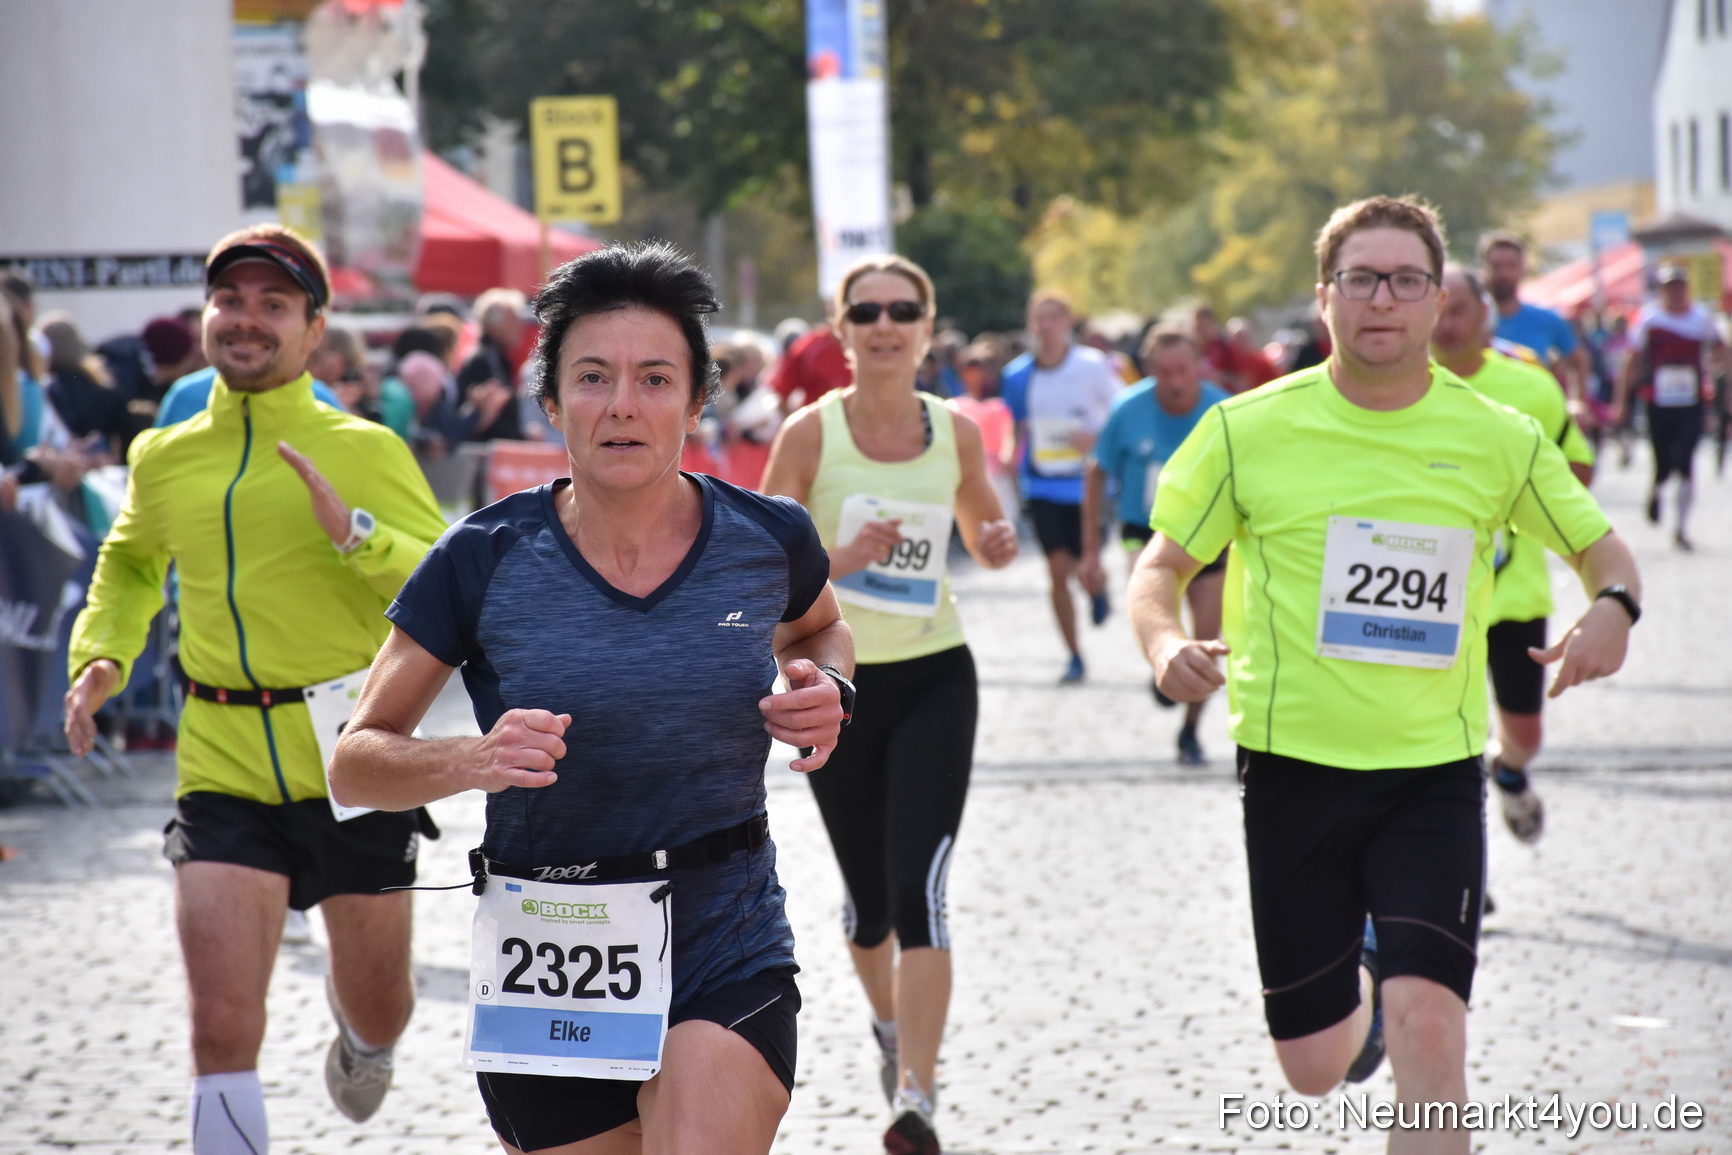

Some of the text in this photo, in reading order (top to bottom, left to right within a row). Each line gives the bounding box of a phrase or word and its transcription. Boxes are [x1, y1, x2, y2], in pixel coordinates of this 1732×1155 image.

[557, 138, 596, 194] B
[1345, 563, 1448, 612] 2294
[1362, 621, 1426, 643] Christian
[540, 901, 609, 919] BOCK
[501, 937, 642, 1001] 2325
[481, 984, 489, 996] D
[549, 1020, 592, 1043] Elke
